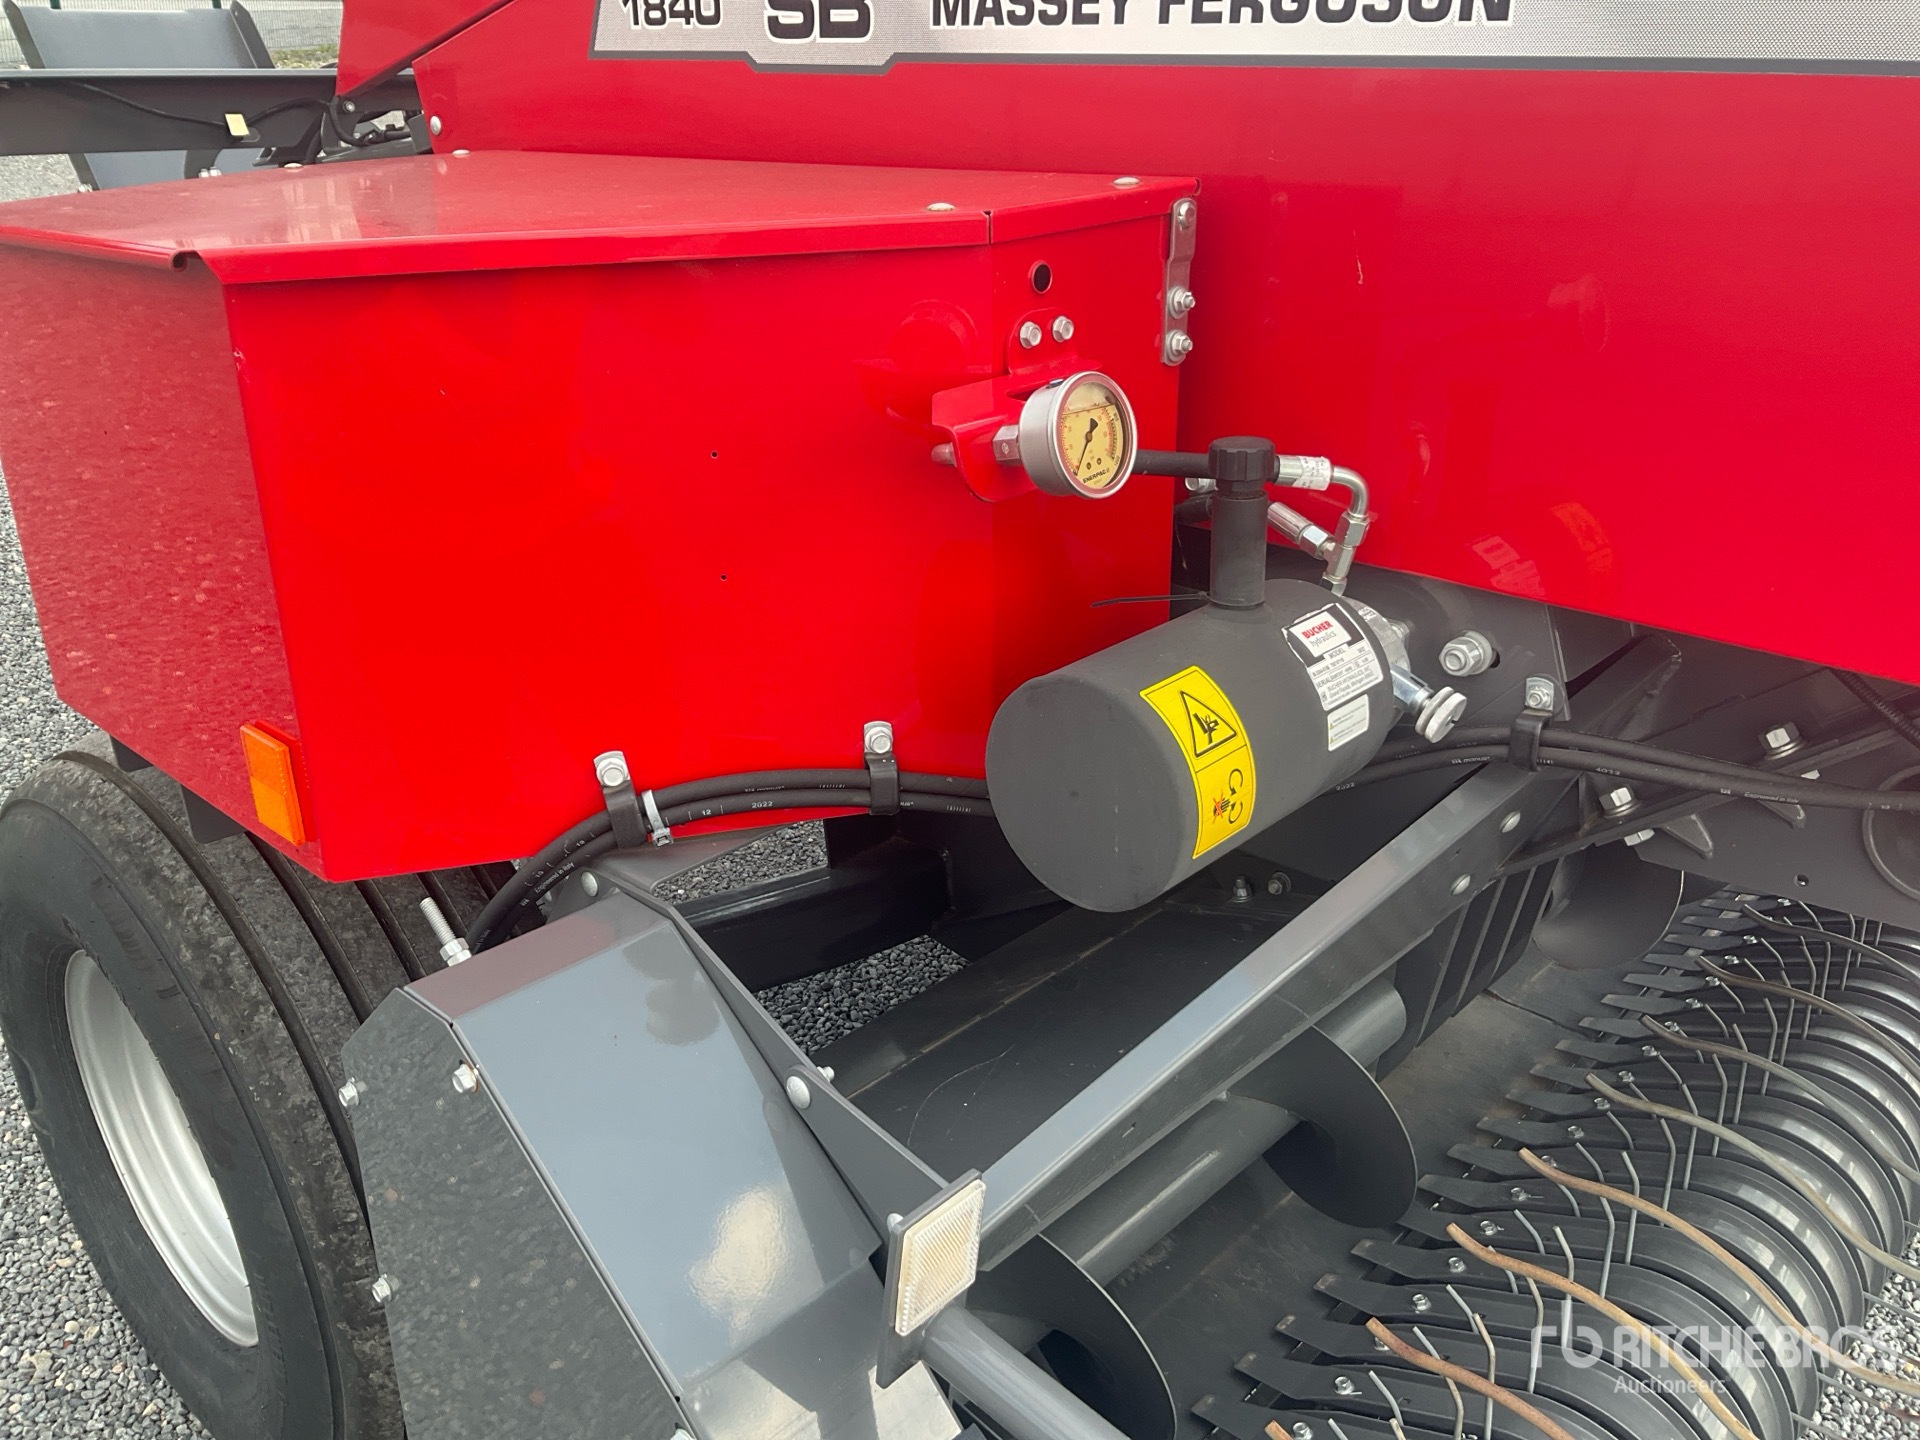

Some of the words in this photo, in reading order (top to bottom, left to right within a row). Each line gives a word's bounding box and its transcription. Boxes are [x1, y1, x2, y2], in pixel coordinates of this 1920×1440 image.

[621, 0, 722, 28] 1840
[1082, 469, 1107, 484] ENERPAC
[1302, 620, 1334, 639] BUCHER
[1308, 630, 1337, 648] hydraulics
[1328, 648, 1346, 660] MODEL
[701, 808, 712, 816] 12
[751, 800, 774, 809] 2022
